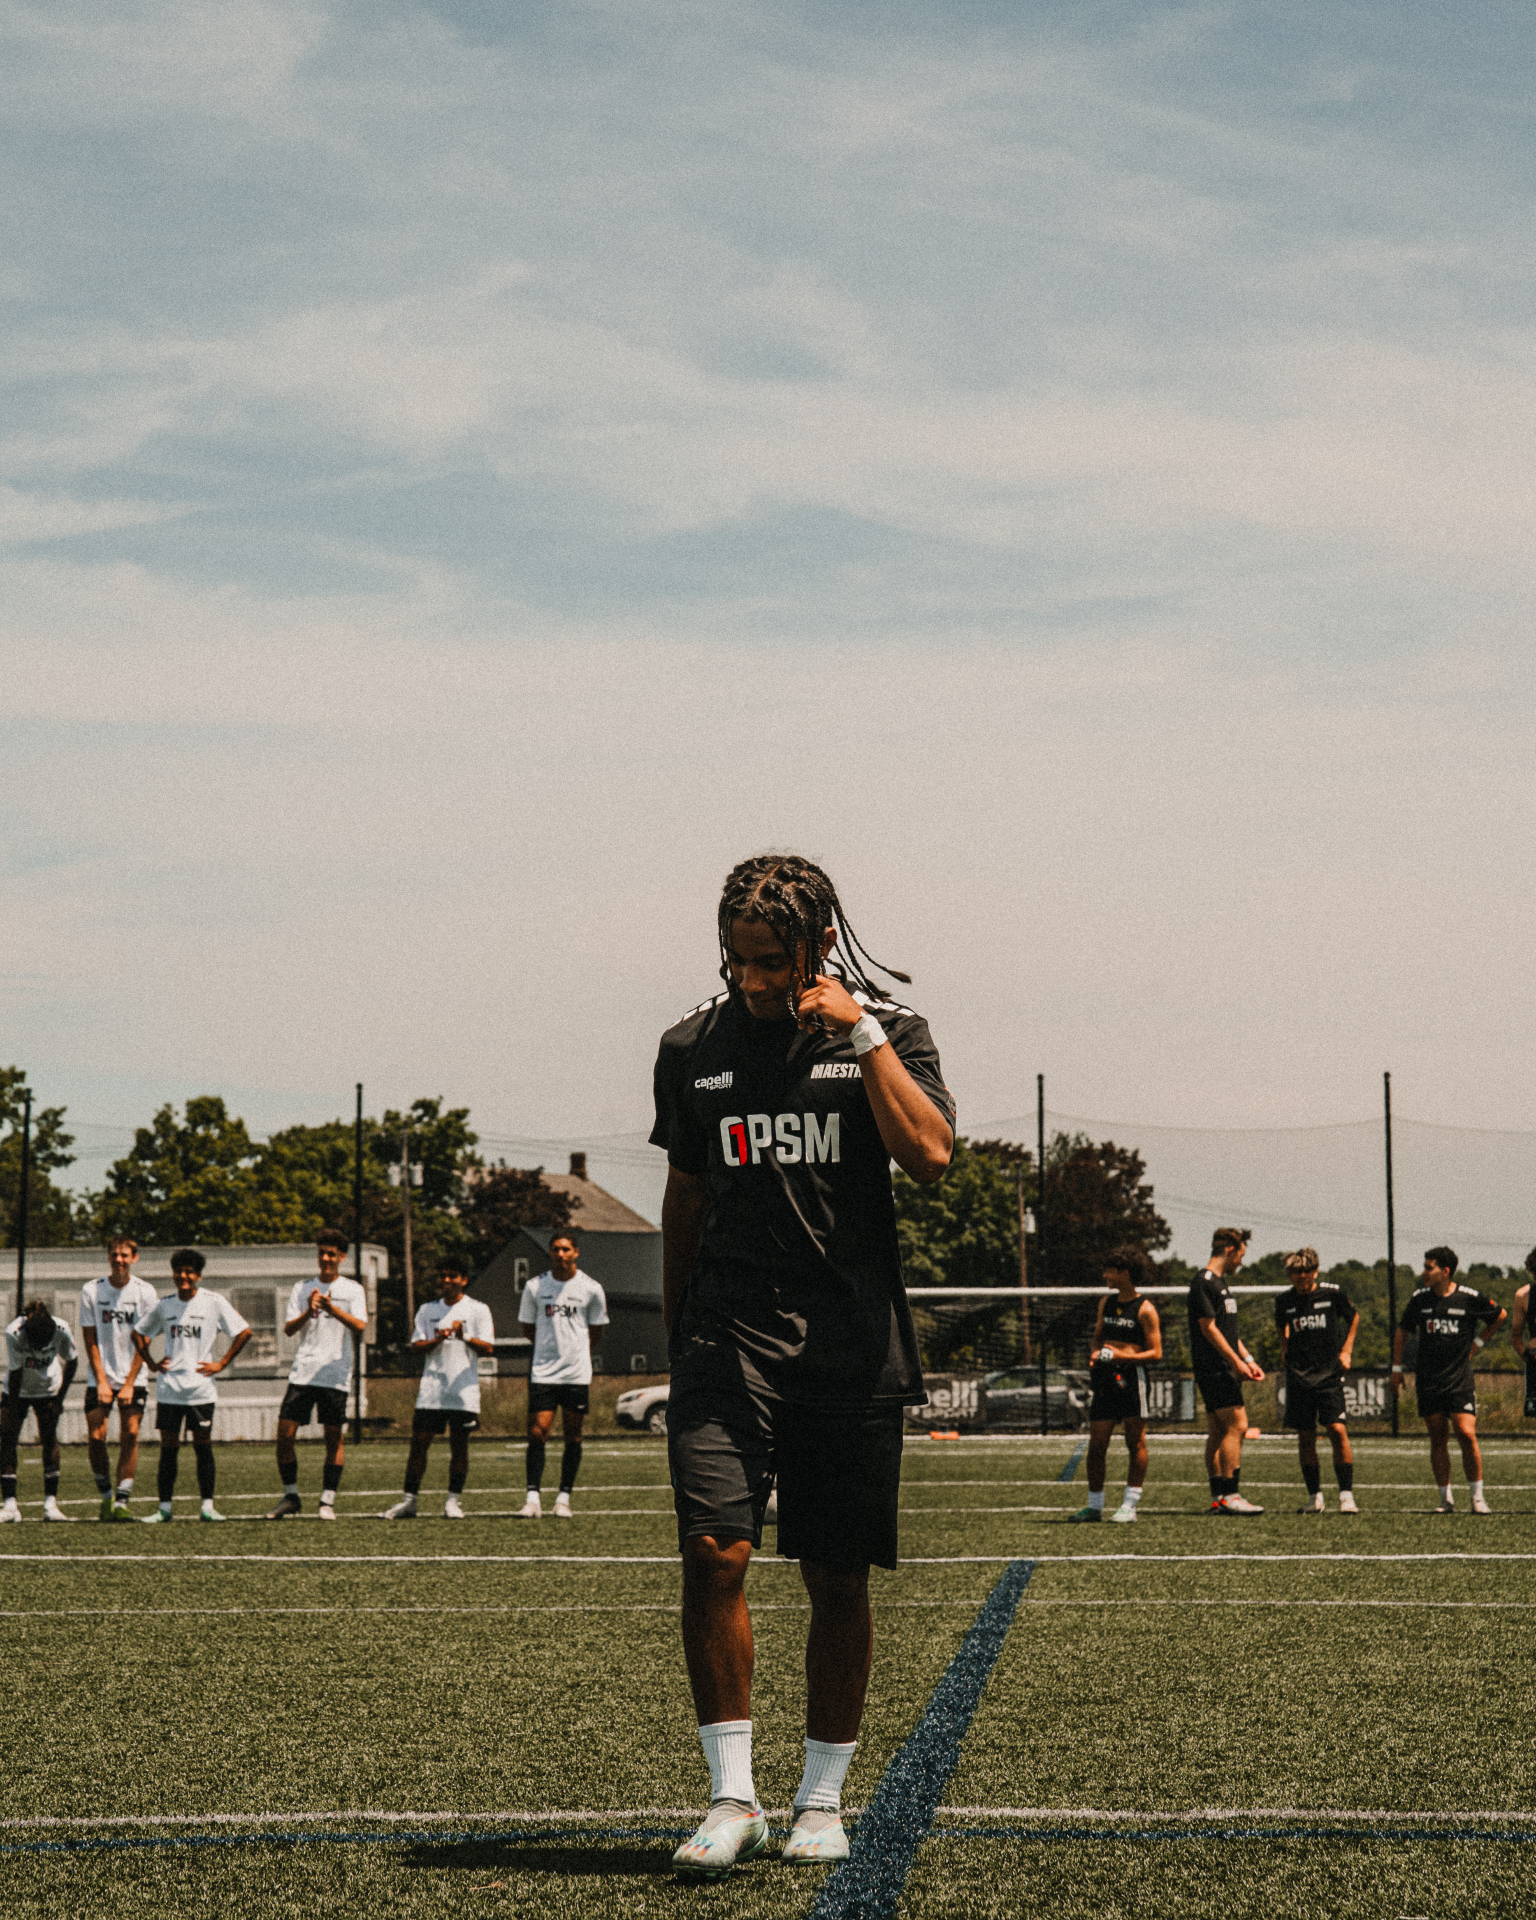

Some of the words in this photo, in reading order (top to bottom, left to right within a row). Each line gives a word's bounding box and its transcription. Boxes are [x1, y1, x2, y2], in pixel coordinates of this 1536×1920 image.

[694, 1071, 733, 1090] capelli
[709, 1083, 733, 1091] SPORT
[1345, 1404, 1383, 1417] PORT
